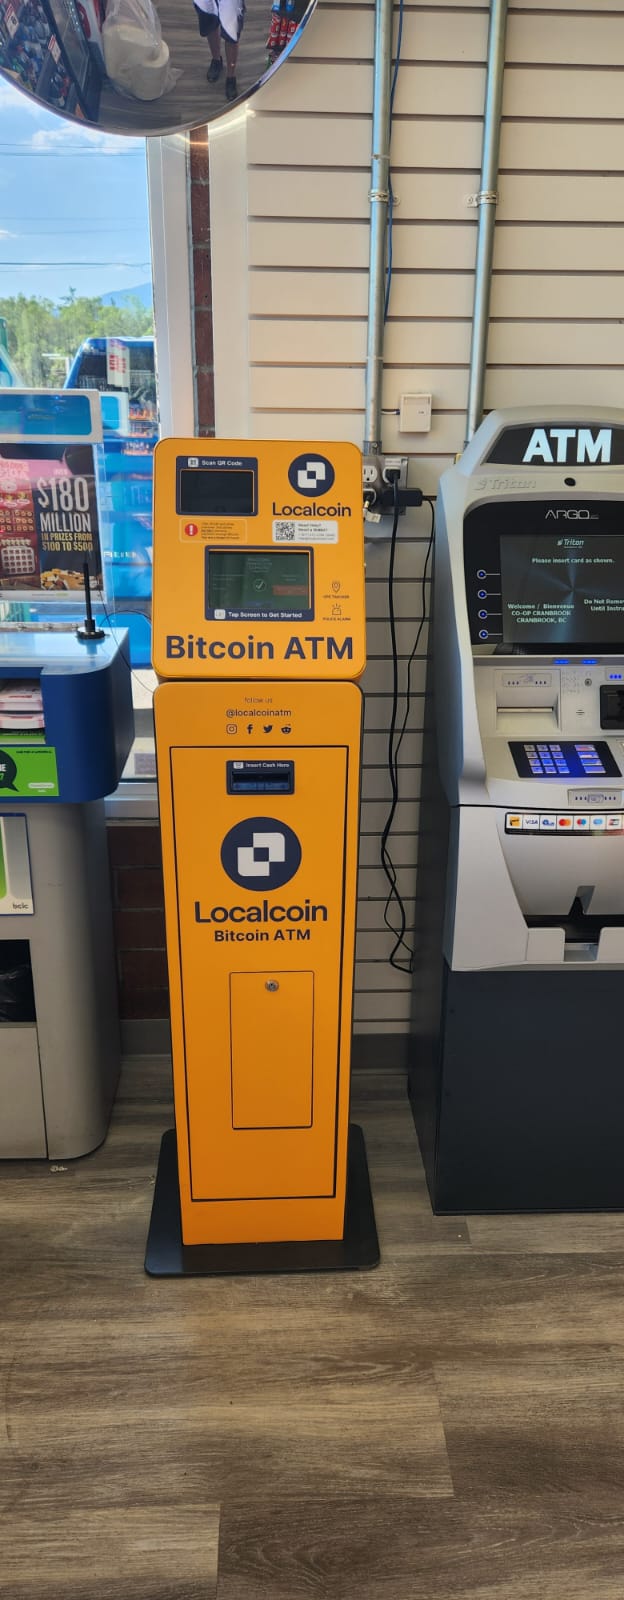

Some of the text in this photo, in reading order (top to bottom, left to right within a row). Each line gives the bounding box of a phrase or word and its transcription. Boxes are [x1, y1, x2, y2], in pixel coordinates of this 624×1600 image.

[522, 428, 612, 463] ATM
[489, 480, 536, 490] Triton
[36, 477, 90, 512] $180
[272, 502, 352, 517] Localcoin
[545, 510, 590, 520] ARGO
[40, 513, 92, 532] MILLION
[42, 533, 92, 541] IN PRIZES FROM
[42, 542, 93, 551] $100 TO $500
[166, 634, 353, 660] Bitcoin ATM
[226, 708, 292, 718] @localcoinatm
[195, 899, 328, 923] Localcoin
[214, 929, 310, 942] Bitcoin ATM
